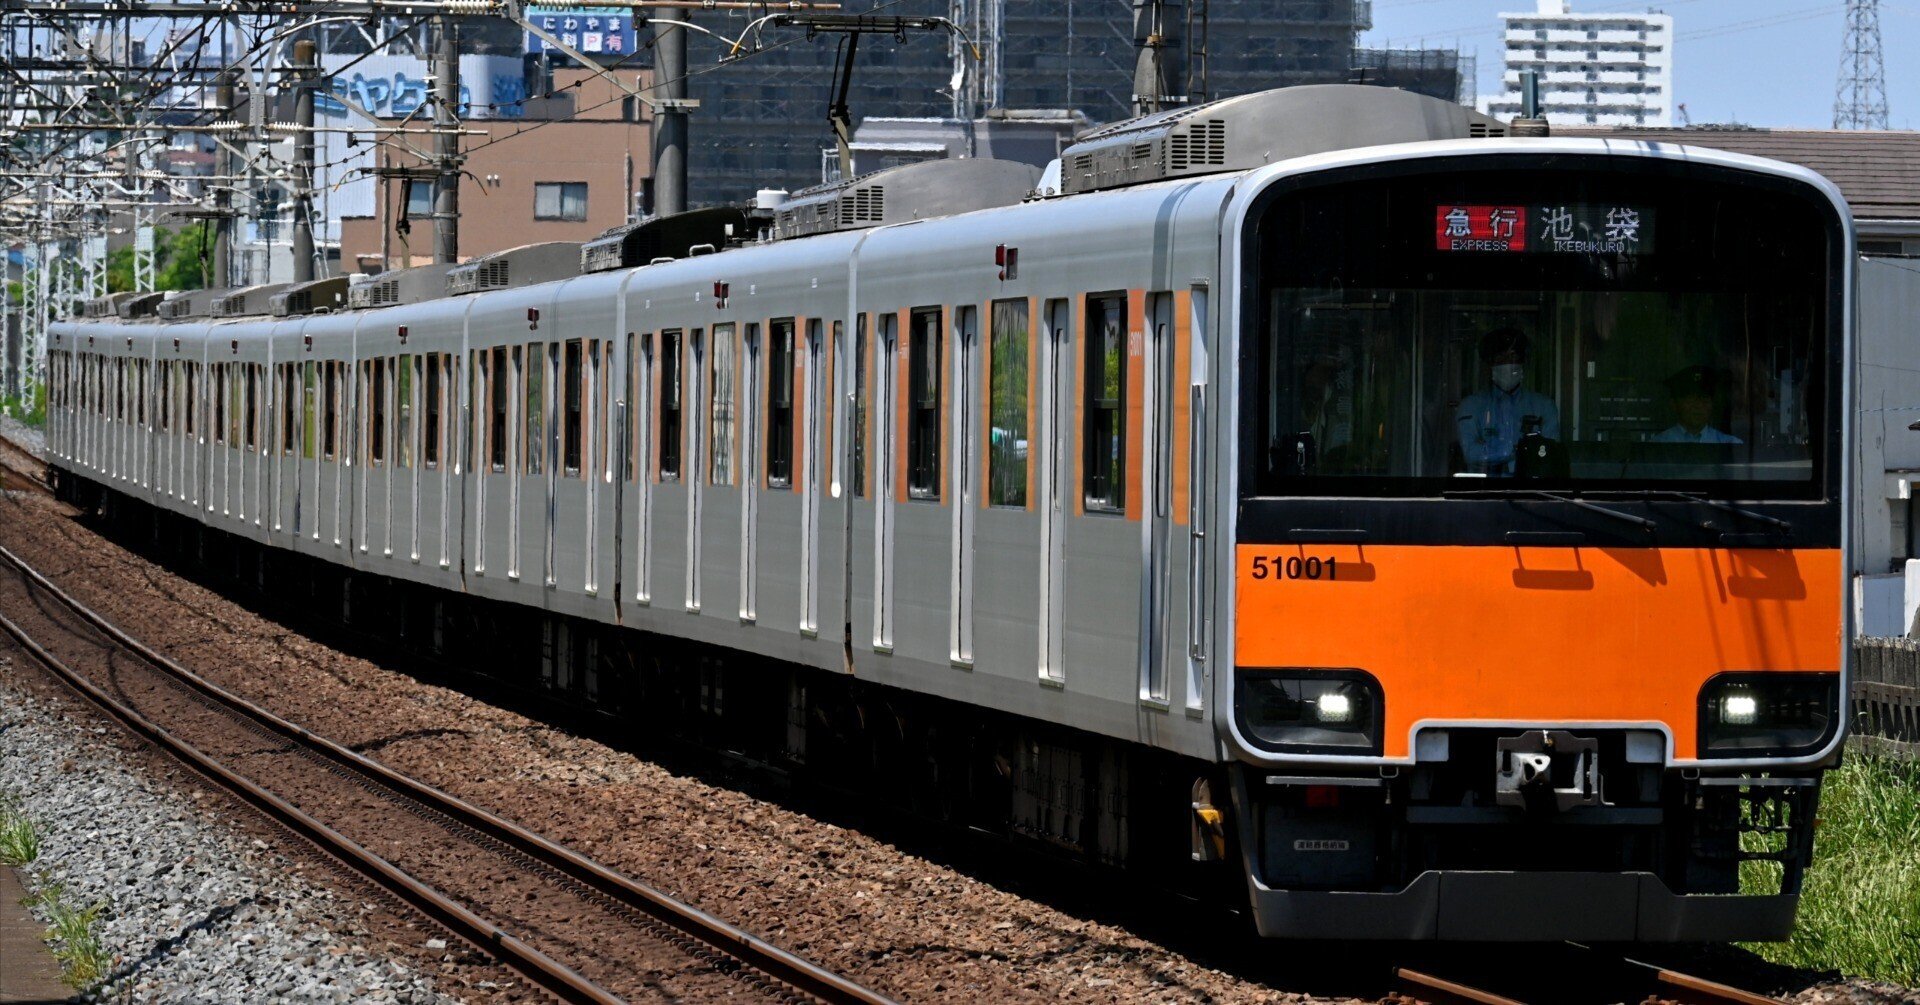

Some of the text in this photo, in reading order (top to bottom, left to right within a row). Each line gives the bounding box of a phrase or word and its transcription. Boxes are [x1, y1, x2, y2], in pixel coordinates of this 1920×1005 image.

[543, 16, 621, 31] にわやま
[1445, 206, 1640, 242] 急行 池袋
[1451, 239, 1625, 253] EXPRESS IKEBUKURO
[1252, 556, 1336, 580] 51001
